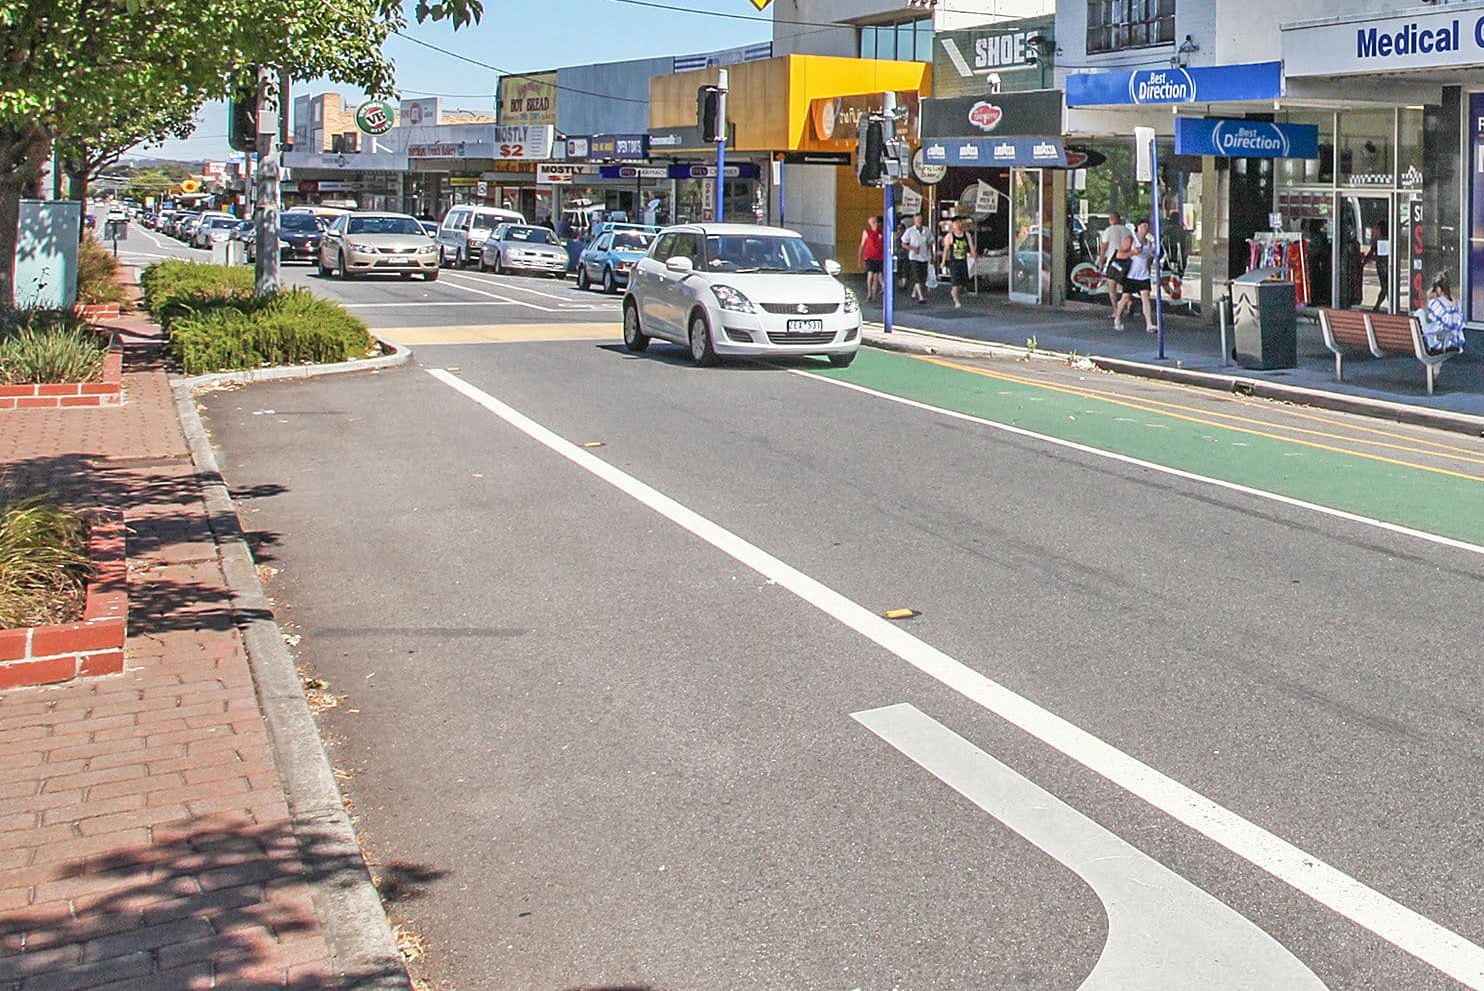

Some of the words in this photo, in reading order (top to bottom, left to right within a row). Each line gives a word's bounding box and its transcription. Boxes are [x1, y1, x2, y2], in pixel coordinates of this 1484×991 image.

[1357, 20, 1459, 58] Medical
[975, 31, 1038, 67] SHOES
[1150, 72, 1166, 84] Best
[1139, 80, 1187, 99] Direction
[527, 97, 550, 111] BREAD
[366, 110, 386, 125] VB
[495, 126, 529, 142] MOSTLY
[1239, 127, 1257, 137] Best
[1223, 134, 1280, 149] Direction
[500, 144, 524, 156] $2
[541, 165, 584, 174] MOSTLY
